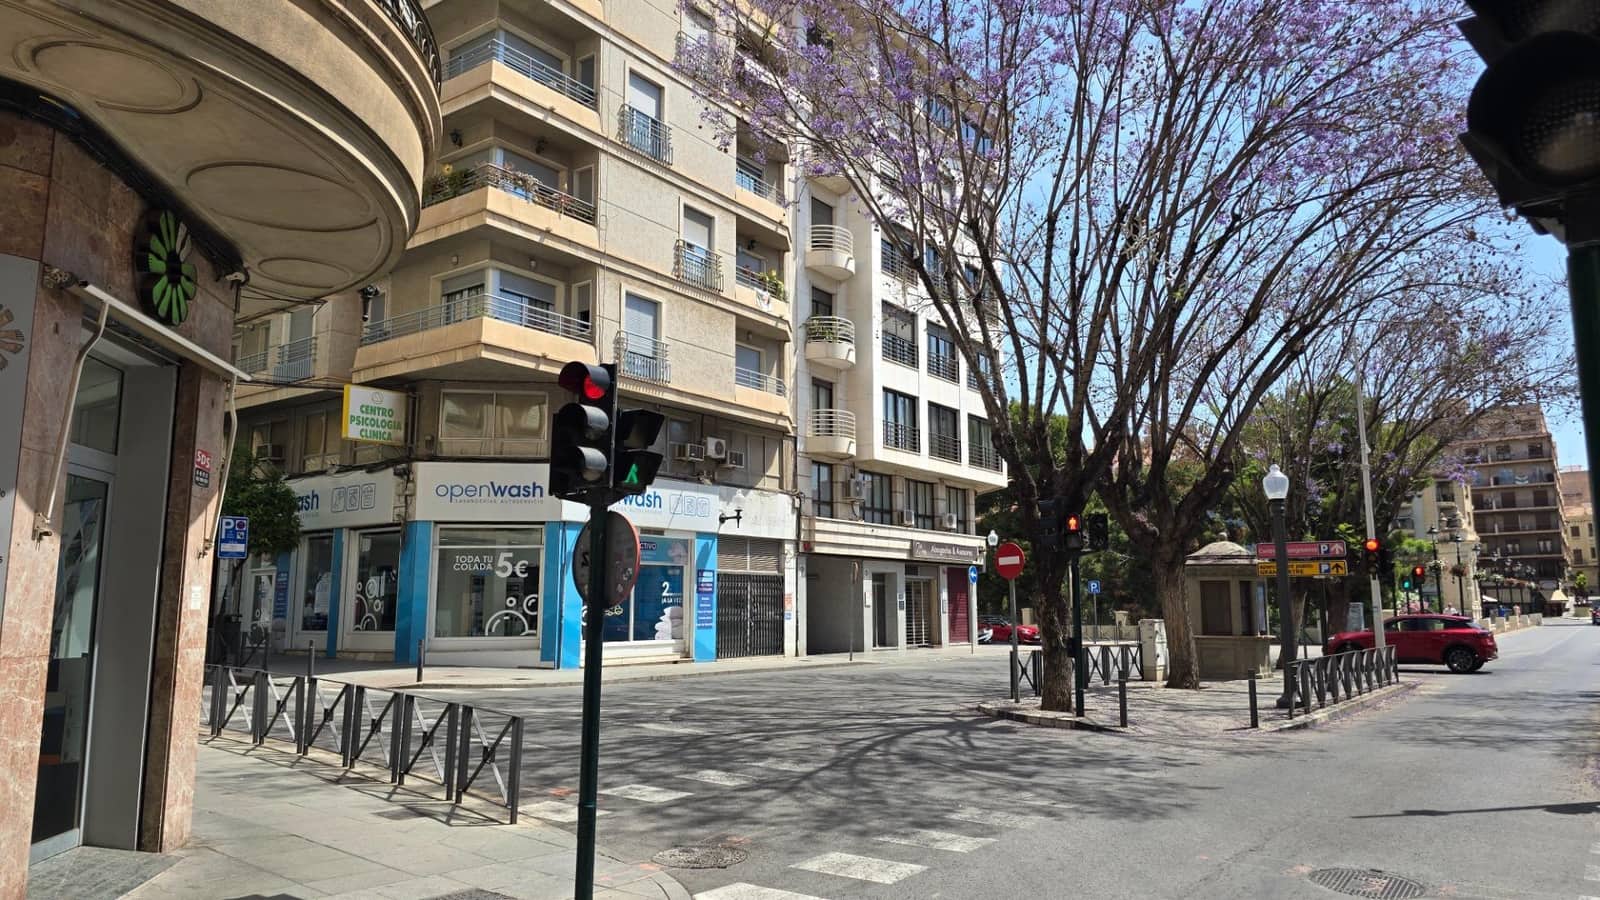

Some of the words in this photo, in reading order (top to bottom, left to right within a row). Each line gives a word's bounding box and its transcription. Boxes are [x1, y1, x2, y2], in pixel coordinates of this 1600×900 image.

[360, 404, 394, 418] CENTRO
[435, 481, 544, 503] openwash
[221, 518, 235, 539] P
[1321, 544, 1329, 555] P
[455, 555, 481, 563] TODA
[483, 555, 494, 563] TU
[453, 562, 494, 571] COLADA
[1322, 564, 1330, 574] P
